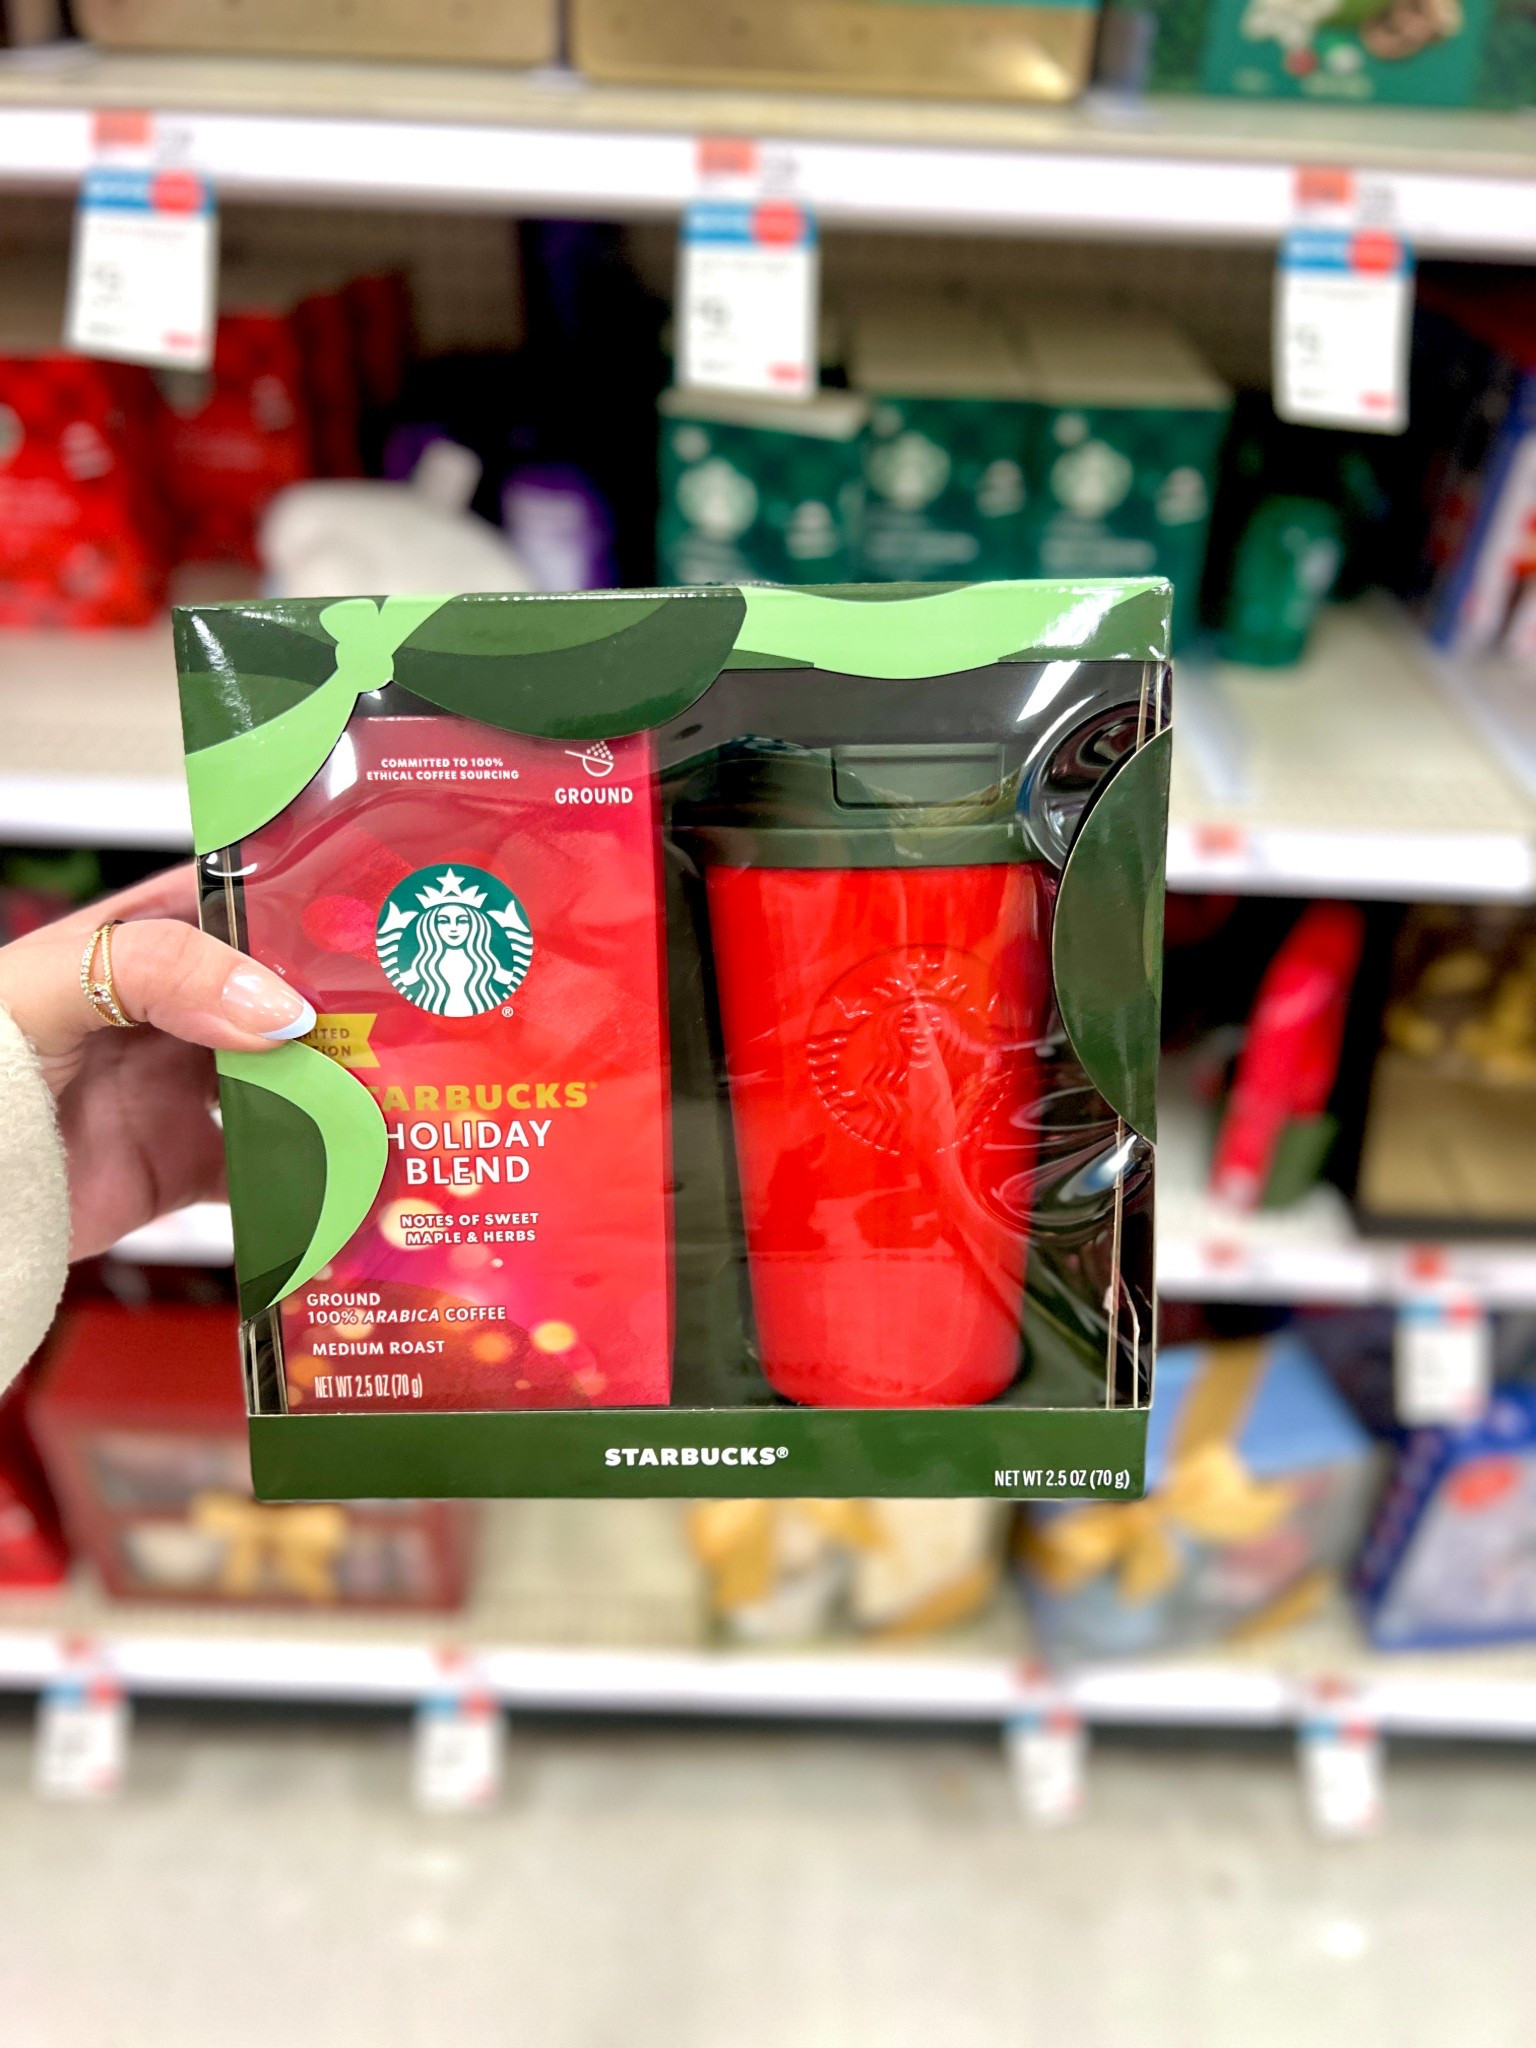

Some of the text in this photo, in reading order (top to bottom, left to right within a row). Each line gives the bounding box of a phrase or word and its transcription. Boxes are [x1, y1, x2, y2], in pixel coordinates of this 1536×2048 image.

[381, 758, 503, 768] COMMITTED TO 100%
[367, 770, 519, 780] ETHICAL COFFEE SOURCING
[554, 787, 633, 804] GROUND
[302, 1028, 350, 1040] ITED
[385, 1119, 552, 1150] HOLIDAY
[406, 1155, 530, 1185] BLEND
[401, 1212, 539, 1227] NOTES OF SWEET
[407, 1230, 536, 1244] MAPLE & HERBS
[306, 1292, 381, 1307] GROUND
[308, 1306, 506, 1324] 100% ARABICA COFFEE
[312, 1340, 445, 1356] MEDIUM ROAST
[314, 1373, 423, 1399] NET WT 2.5 OZ (70 g)
[994, 1469, 1130, 1490] NET WT 2.5 OZ (70 g)
